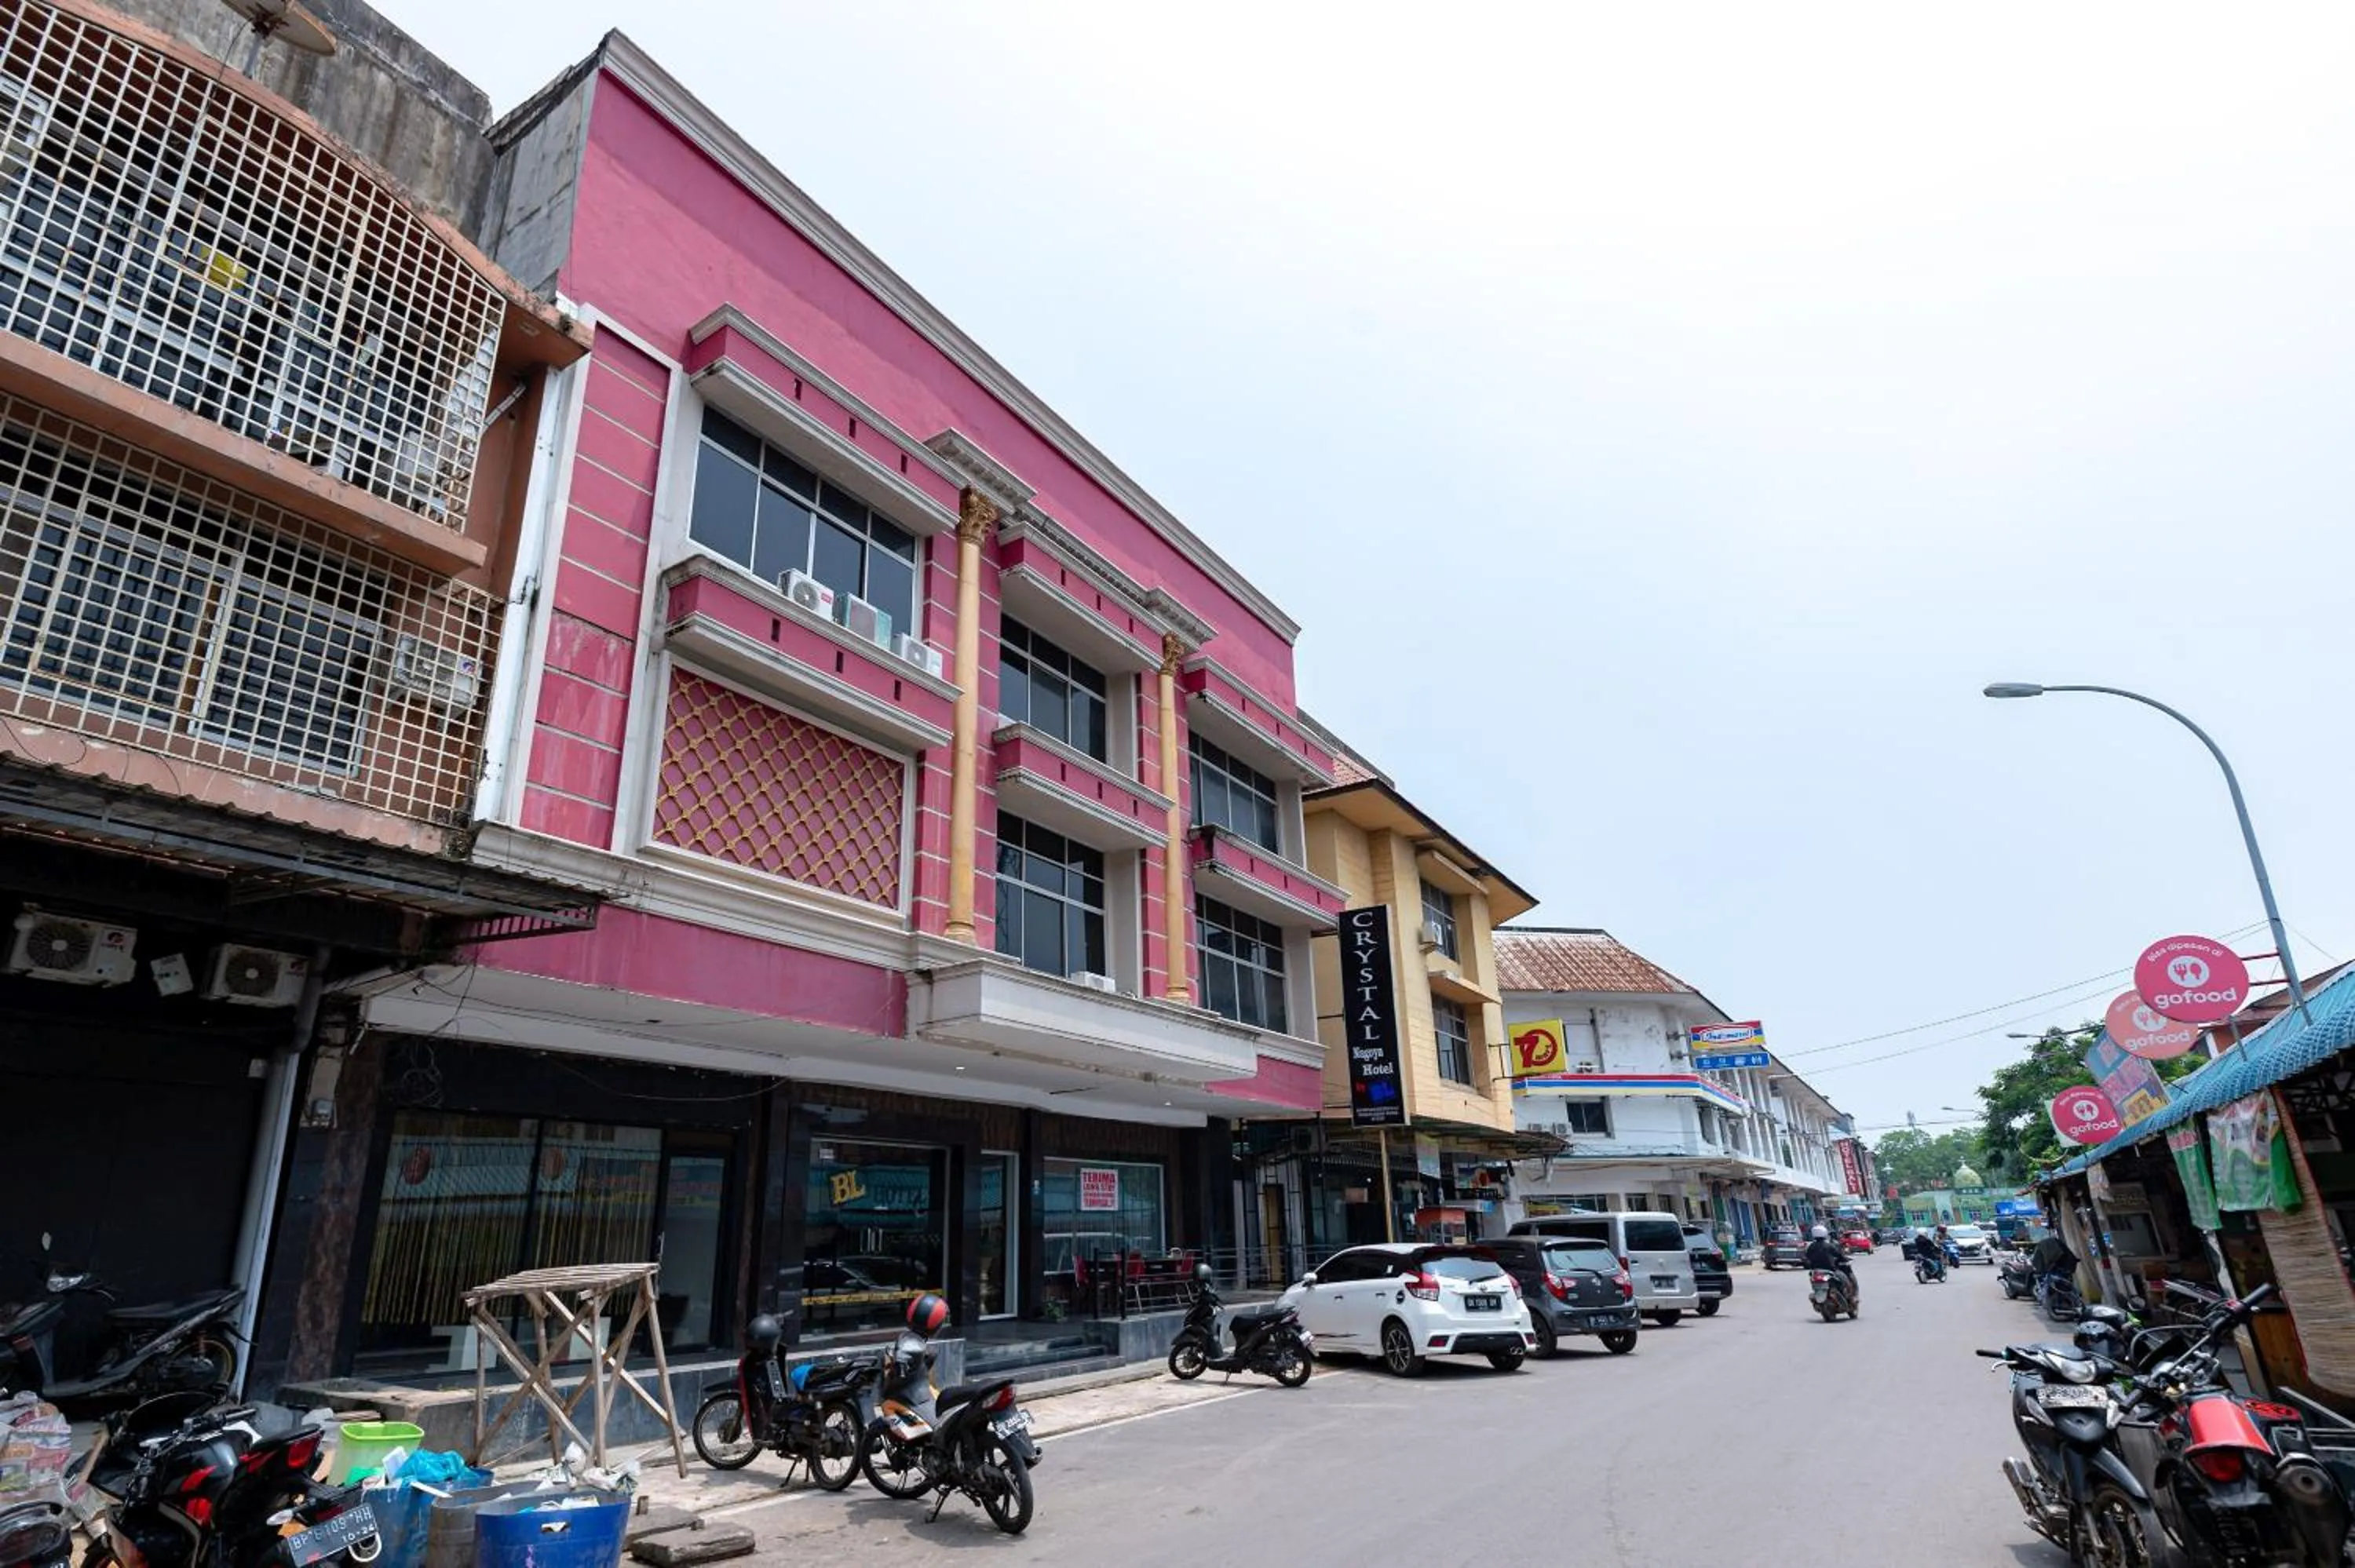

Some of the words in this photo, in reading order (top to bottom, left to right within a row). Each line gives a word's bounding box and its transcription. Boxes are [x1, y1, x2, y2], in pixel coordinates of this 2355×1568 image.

[1352, 911, 1382, 1040] CRYSTAL
[2154, 987, 2237, 1009] gofood
[2125, 1030, 2189, 1051] gofood
[1362, 1062, 1394, 1076] Hotel
[2069, 1118, 2118, 1137] gofood
[830, 1169, 866, 1205] BL
[1083, 1172, 1115, 1183] TERIMA
